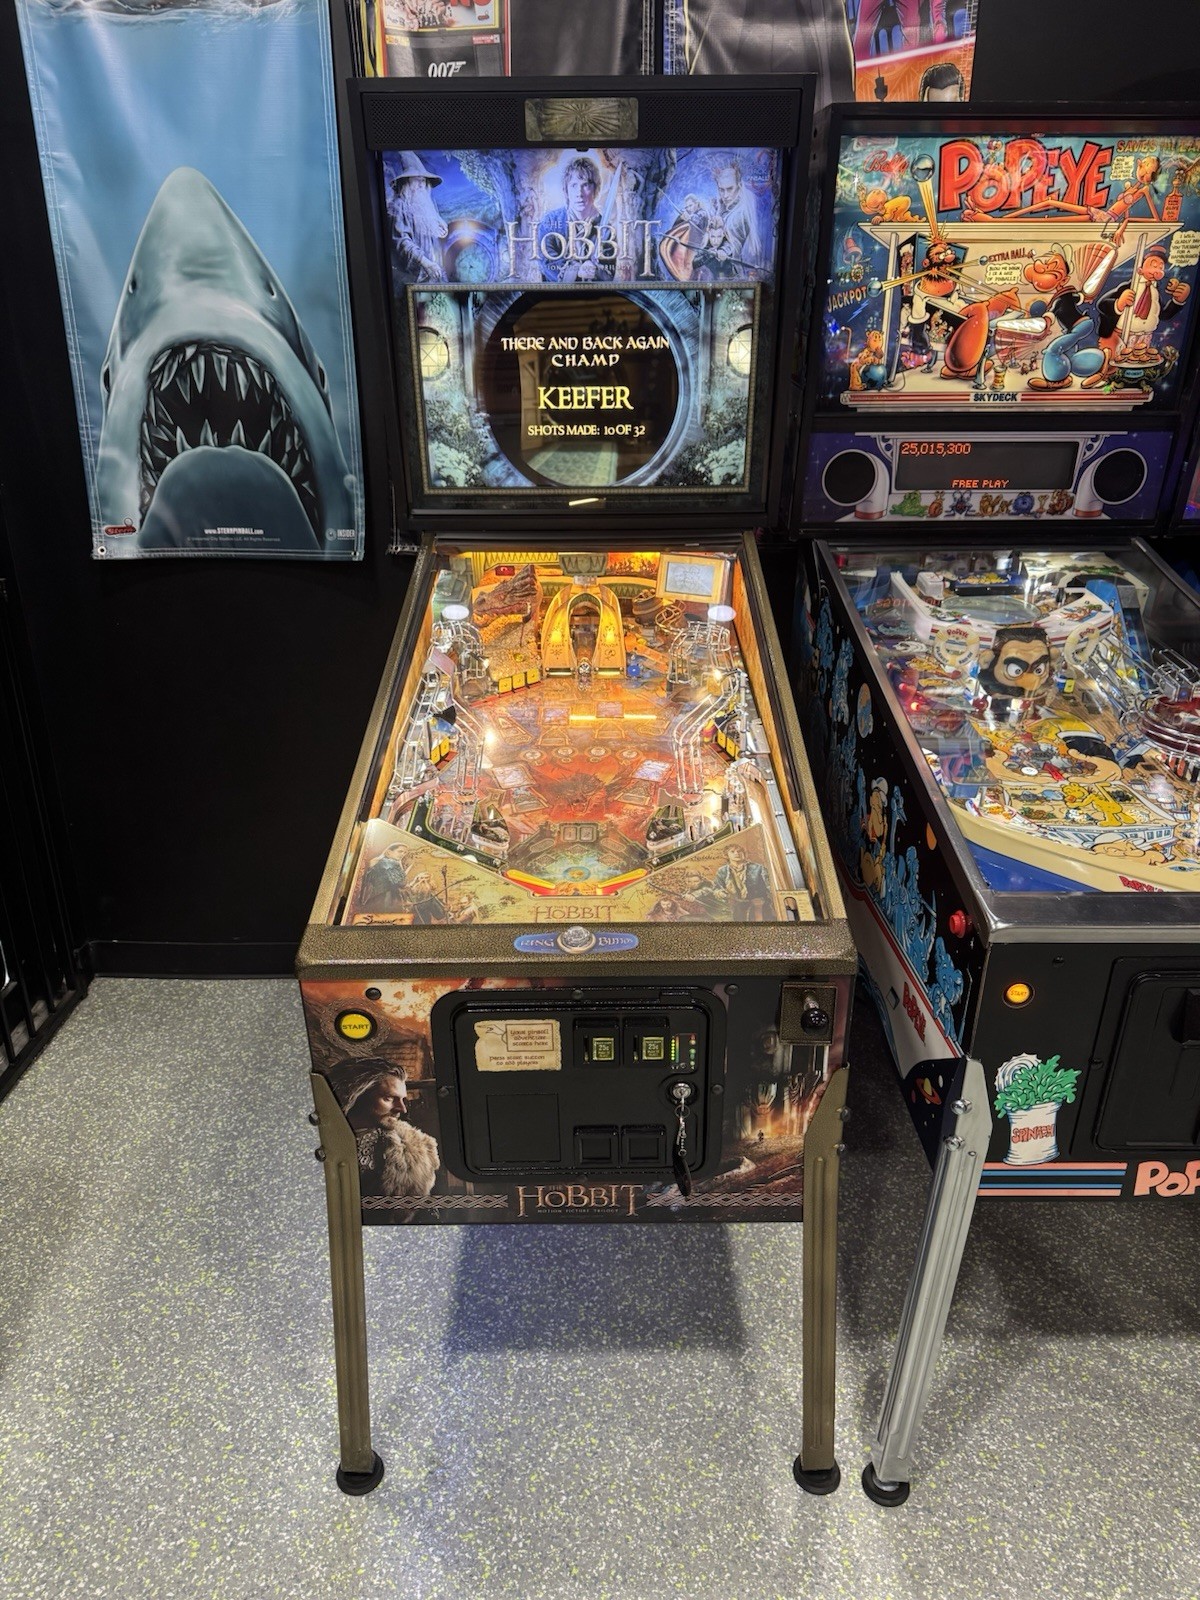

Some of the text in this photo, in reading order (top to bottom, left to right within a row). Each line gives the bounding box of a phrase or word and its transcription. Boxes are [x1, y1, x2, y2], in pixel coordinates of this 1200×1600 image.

[428, 61, 466, 77] 007
[1117, 139, 1158, 153] SAVES
[864, 150, 909, 174] Bally
[938, 138, 1114, 213] POPEYE
[506, 220, 662, 278] HOBBIT
[989, 247, 1025, 262] EXTRA BALL
[827, 286, 867, 313] JACKPOT
[501, 336, 669, 350] THERE AND BACK AGAIN
[551, 354, 620, 367] CHAMP
[538, 386, 634, 410] KEEFER
[973, 392, 1018, 402] SKYDECK
[528, 425, 565, 436] SHOTS
[566, 425, 600, 436] MADE:
[616, 425, 631, 435] OF
[633, 426, 645, 437] 32
[901, 442, 971, 457] 25,015,300
[952, 479, 1009, 488] FREE PLAY
[337, 529, 355, 538] INSIDER
[946, 628, 970, 638] POPEYE
[532, 905, 617, 923] HOBBIT
[1011, 1124, 1055, 1144] SPINACH
[515, 1184, 643, 1217] HOBBIT
